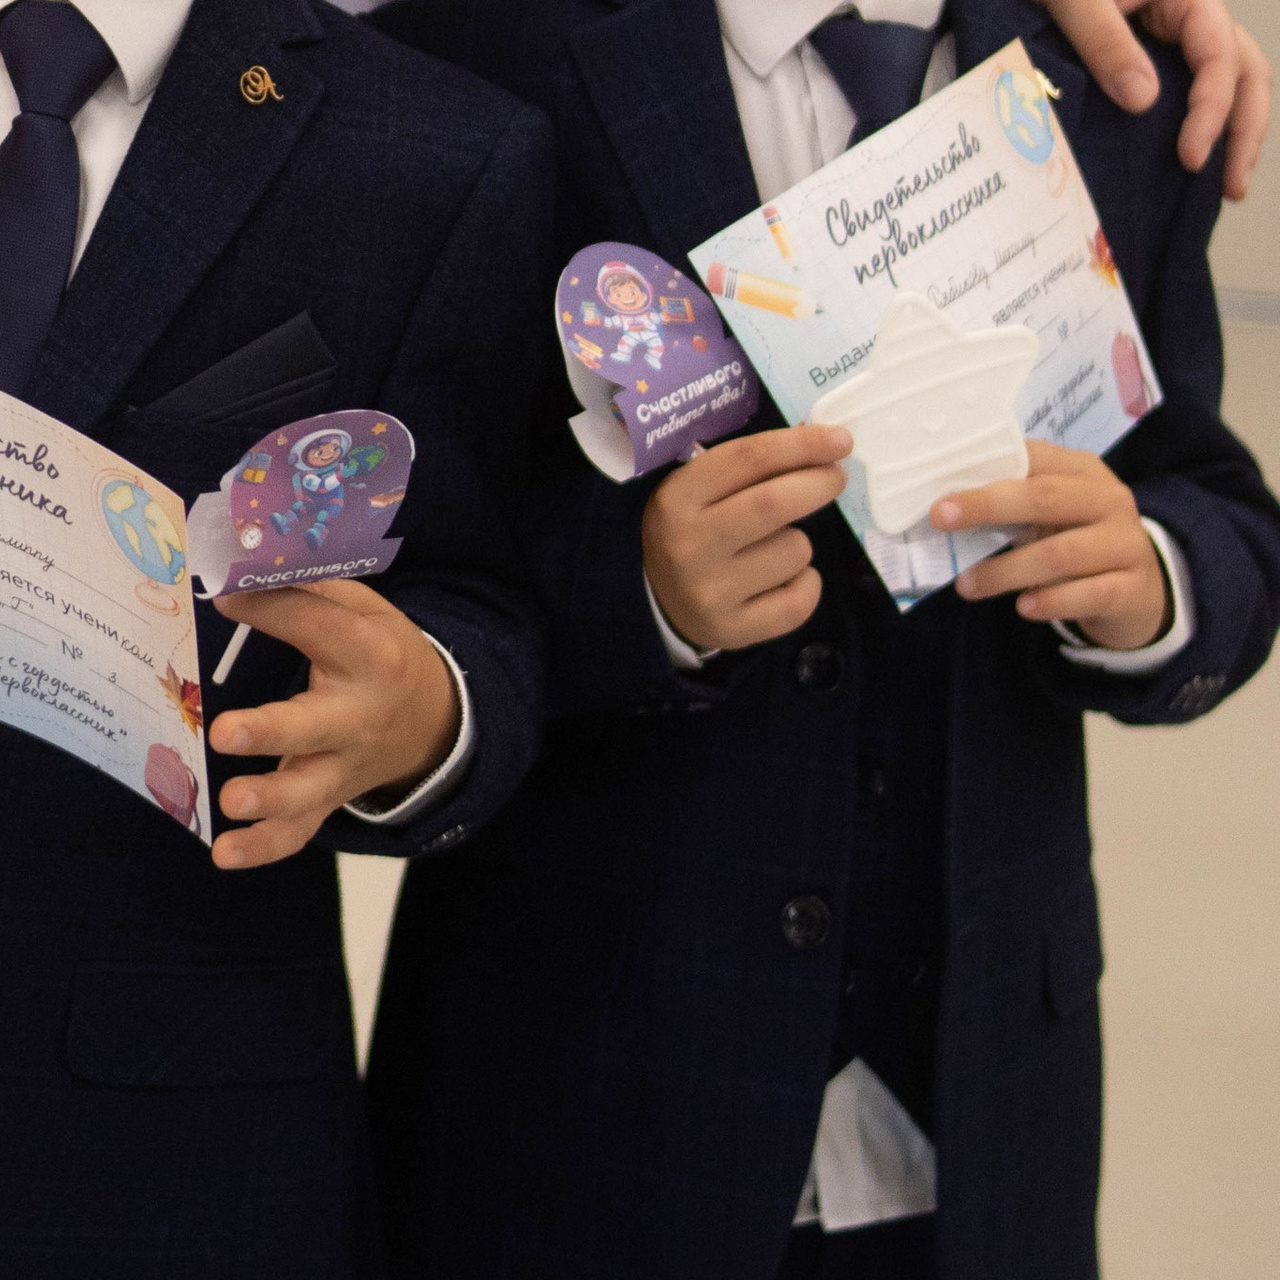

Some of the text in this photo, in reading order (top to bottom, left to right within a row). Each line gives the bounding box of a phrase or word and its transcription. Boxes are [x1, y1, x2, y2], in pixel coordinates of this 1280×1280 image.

[825, 121, 981, 247] Свидетельство
[853, 170, 1007, 289] первоклассника
[808, 333, 878, 388] Выдан
[636, 360, 742, 424] Счастливого
[645, 379, 747, 449] учебного года!
[237, 556, 379, 589] Счастливого
[61, 638, 84, 661] №
[8, 657, 18, 669] с
[21, 661, 115, 718] гордостью
